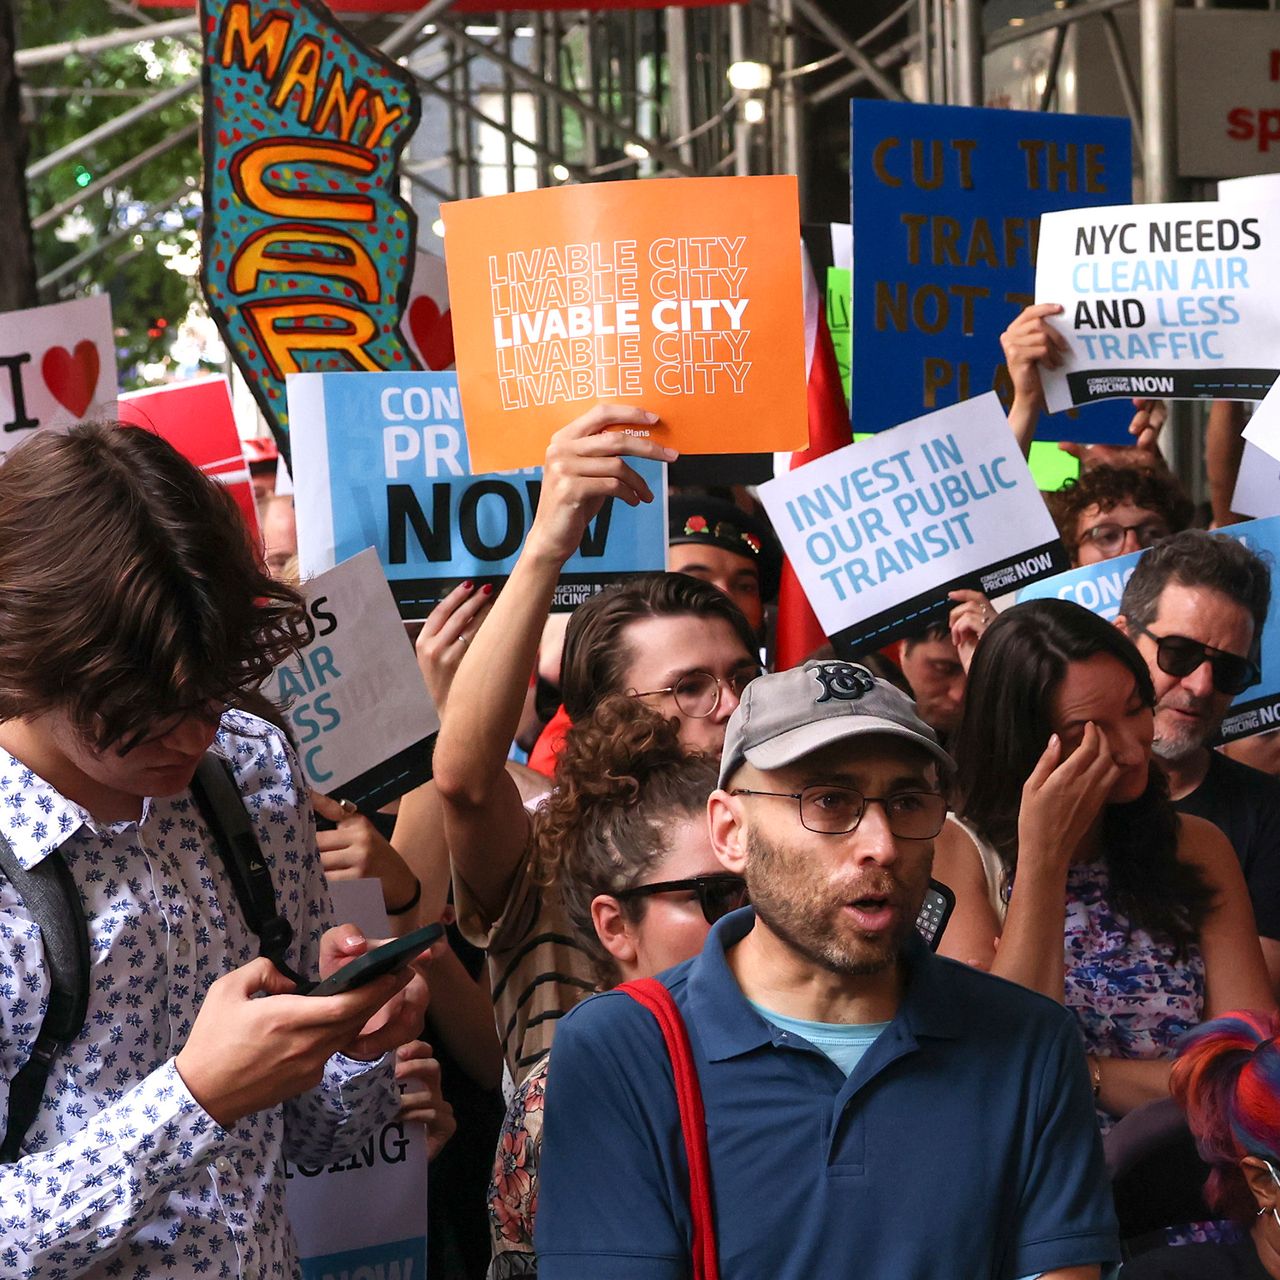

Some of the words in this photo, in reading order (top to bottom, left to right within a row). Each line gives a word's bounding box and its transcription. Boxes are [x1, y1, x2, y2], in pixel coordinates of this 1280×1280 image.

[220, 3, 400, 150] MANY
[872, 138, 976, 191] CUT
[1022, 138, 1106, 193] THE
[901, 212, 1037, 268] TRAF
[1075, 222, 1137, 256] NYC
[1149, 217, 1261, 254] NEEDS
[489, 240, 638, 286] LIVABLE
[649, 237, 747, 270] CITY
[1072, 259, 1180, 294] CLEAN
[1191, 256, 1250, 291] AIR
[491, 271, 639, 317] LIVABLE
[650, 268, 747, 300] CITY
[874, 280, 989, 337] NOT
[1074, 298, 1146, 330] AND
[1156, 295, 1241, 328] LESS
[493, 302, 641, 348] LIVABLE
[651, 299, 749, 332] CITY
[1076, 330, 1224, 361] TRAFFIC
[496, 333, 642, 379] LIVABLE
[653, 331, 750, 363] CITY
[500, 363, 643, 411] LIVABLE
[654, 362, 752, 395] CITY
[1089, 382, 1131, 395] PRICING
[1132, 376, 1174, 393] NOW
[786, 450, 915, 532] INVEST
[921, 434, 964, 474] IN
[806, 507, 892, 566] OUR
[892, 456, 1017, 528] PUBLIC
[820, 511, 975, 601] TRANSIT
[1015, 552, 1053, 579] NOW
[984, 571, 1017, 593] PRICING
[1221, 718, 1259, 737] PRICING
